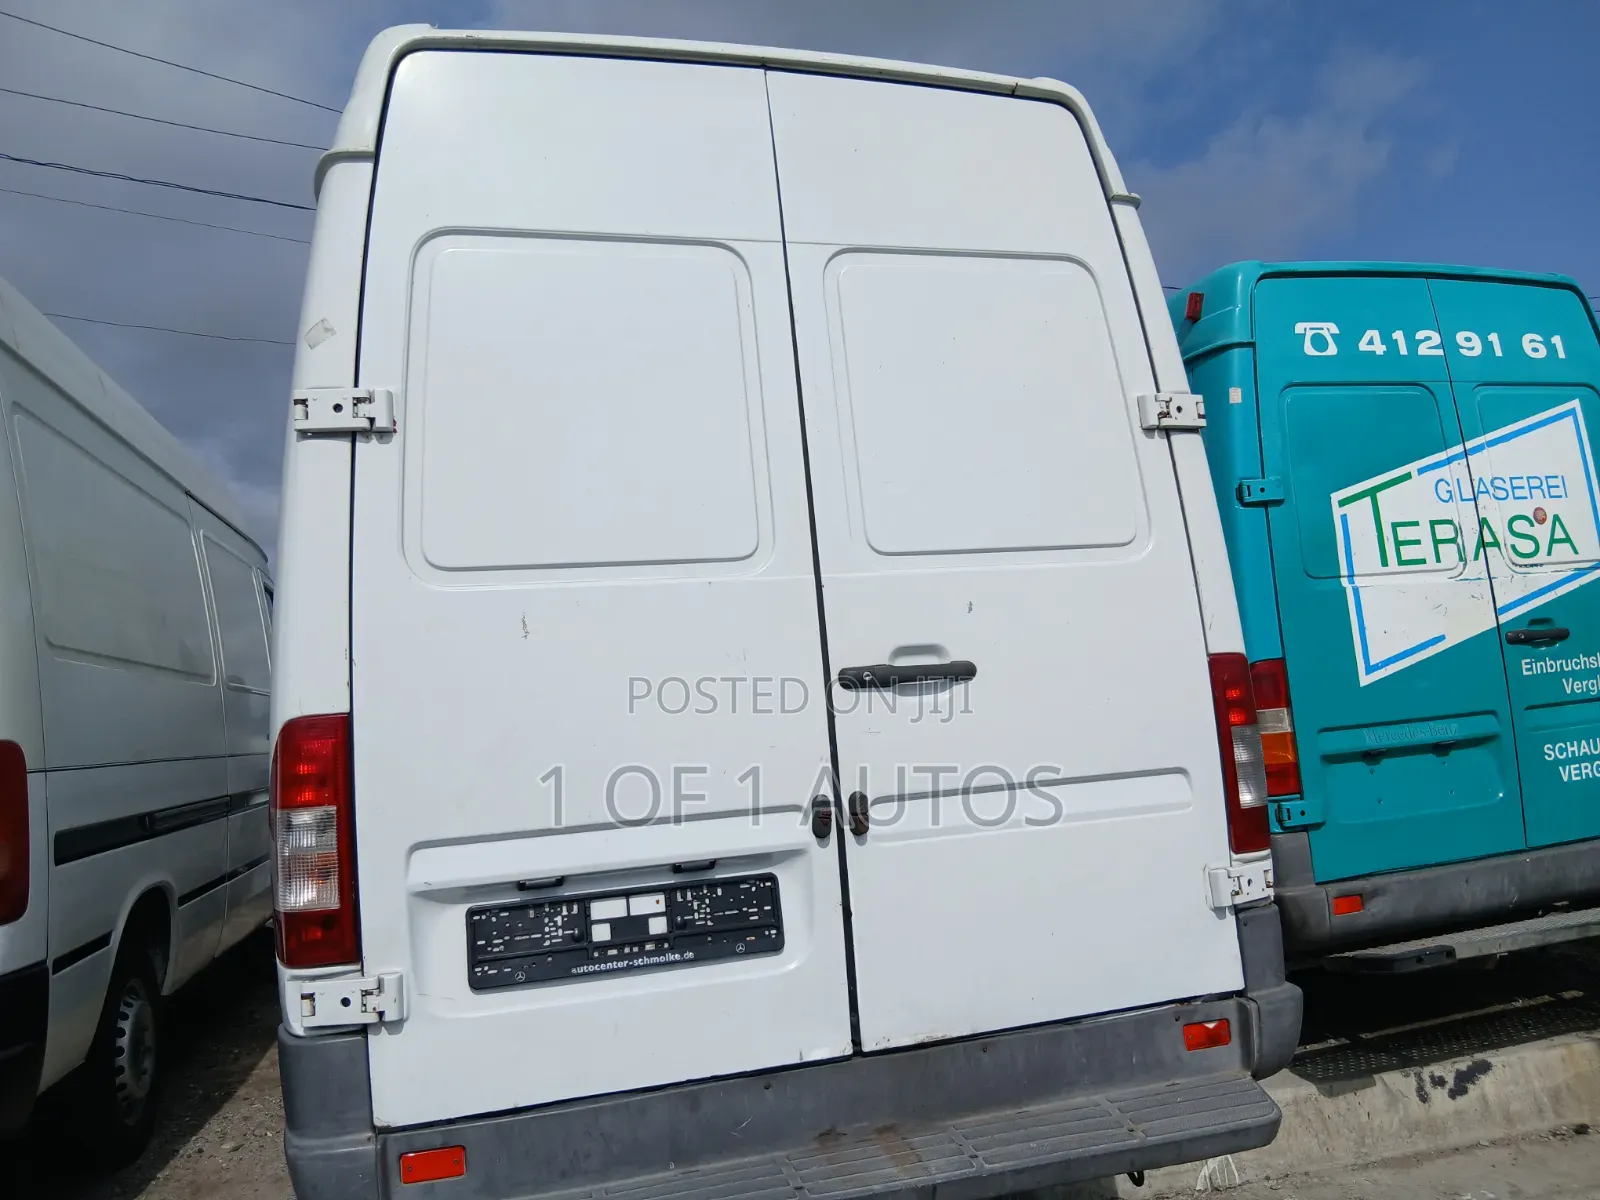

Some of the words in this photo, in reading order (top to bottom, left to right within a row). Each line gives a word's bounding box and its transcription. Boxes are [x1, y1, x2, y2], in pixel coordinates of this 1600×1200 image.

[1358, 329, 1446, 356] 412
[1455, 330, 1503, 357] 91
[1521, 333, 1566, 359] 61
[1434, 474, 1569, 504] GLASEREI
[1337, 471, 1580, 568] TERASA
[570, 950, 695, 975] autocenter-schmolke.de
